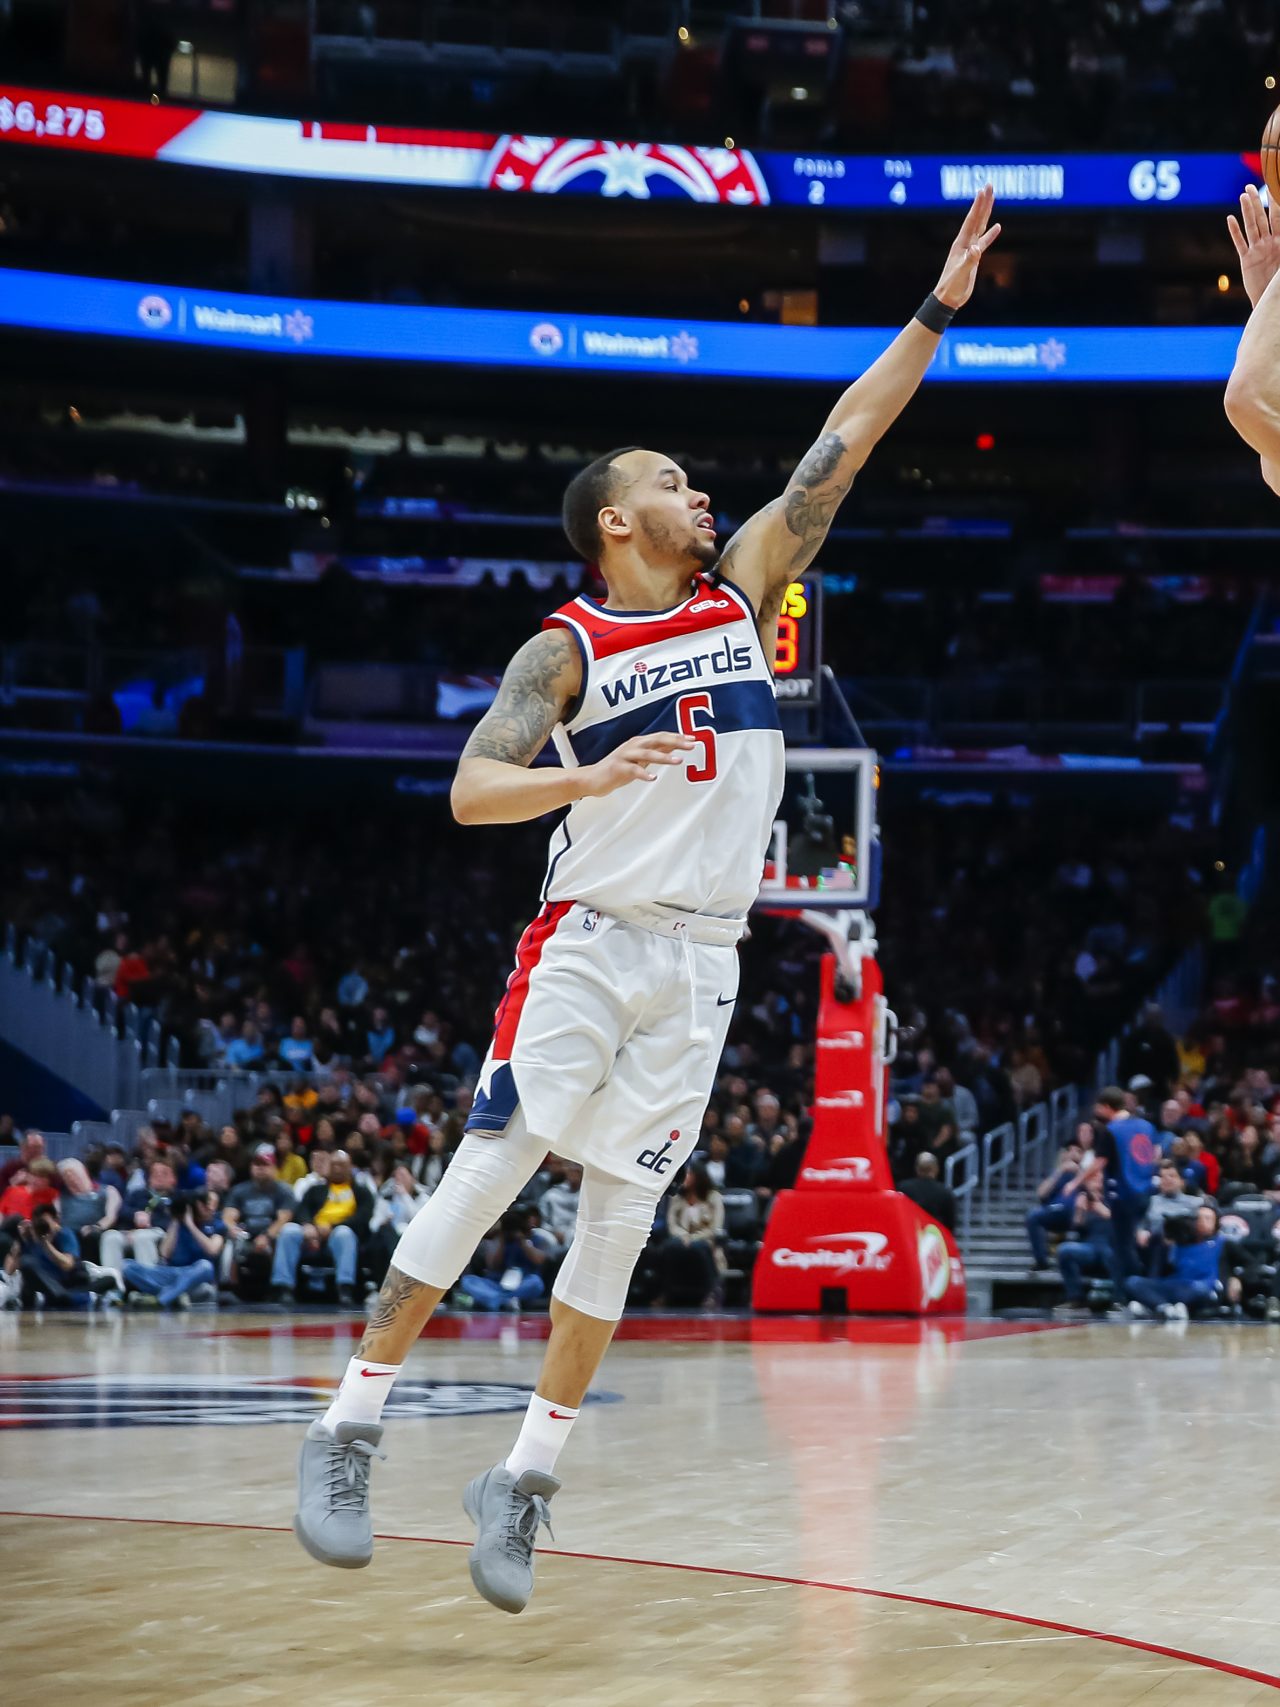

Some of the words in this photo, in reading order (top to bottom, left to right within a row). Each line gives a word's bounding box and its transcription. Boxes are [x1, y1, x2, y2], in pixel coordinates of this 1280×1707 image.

[0, 96, 105, 140] $6,275
[1128, 160, 1181, 201] 65
[194, 304, 283, 336] Walmart
[582, 330, 671, 358] Walmart
[955, 341, 1037, 366] Walmart
[600, 634, 753, 709] wizards
[676, 690, 718, 784] 5
